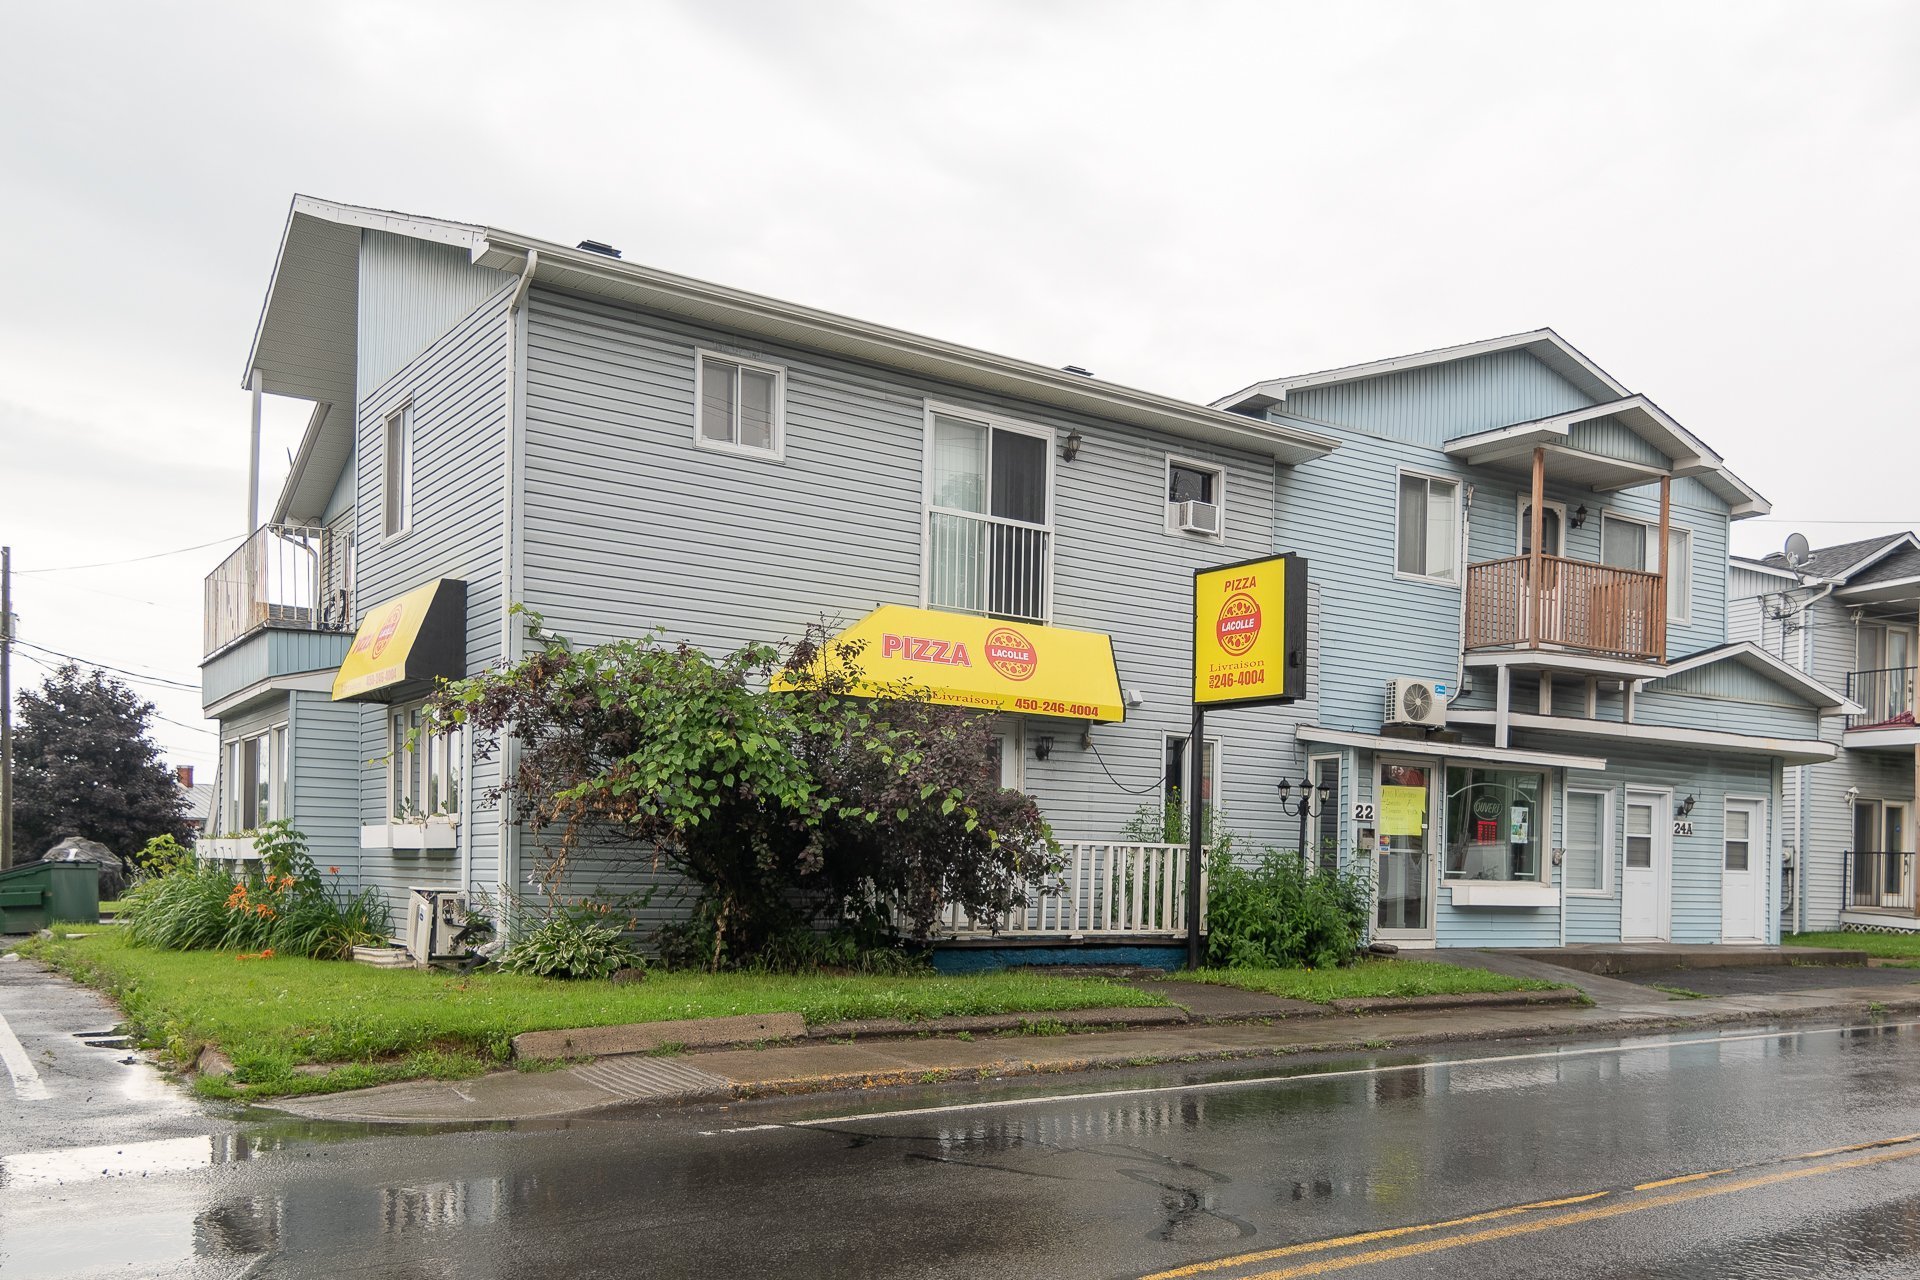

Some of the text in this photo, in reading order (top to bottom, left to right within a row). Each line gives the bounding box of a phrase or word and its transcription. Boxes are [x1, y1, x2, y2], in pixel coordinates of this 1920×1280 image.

[1224, 576, 1256, 592] PIZZA
[1222, 618, 1254, 632] LACOLLE
[882, 633, 972, 667] PIZZA
[991, 648, 1029, 661] LACOLLE
[1209, 660, 1264, 672] Livraison
[1214, 669, 1265, 688] 246-4004
[931, 690, 1099, 717] Livraison 450-246-4004
[1355, 804, 1374, 819] 22
[1475, 802, 1500, 813] OUVERT
[1674, 823, 1692, 834] 24A
